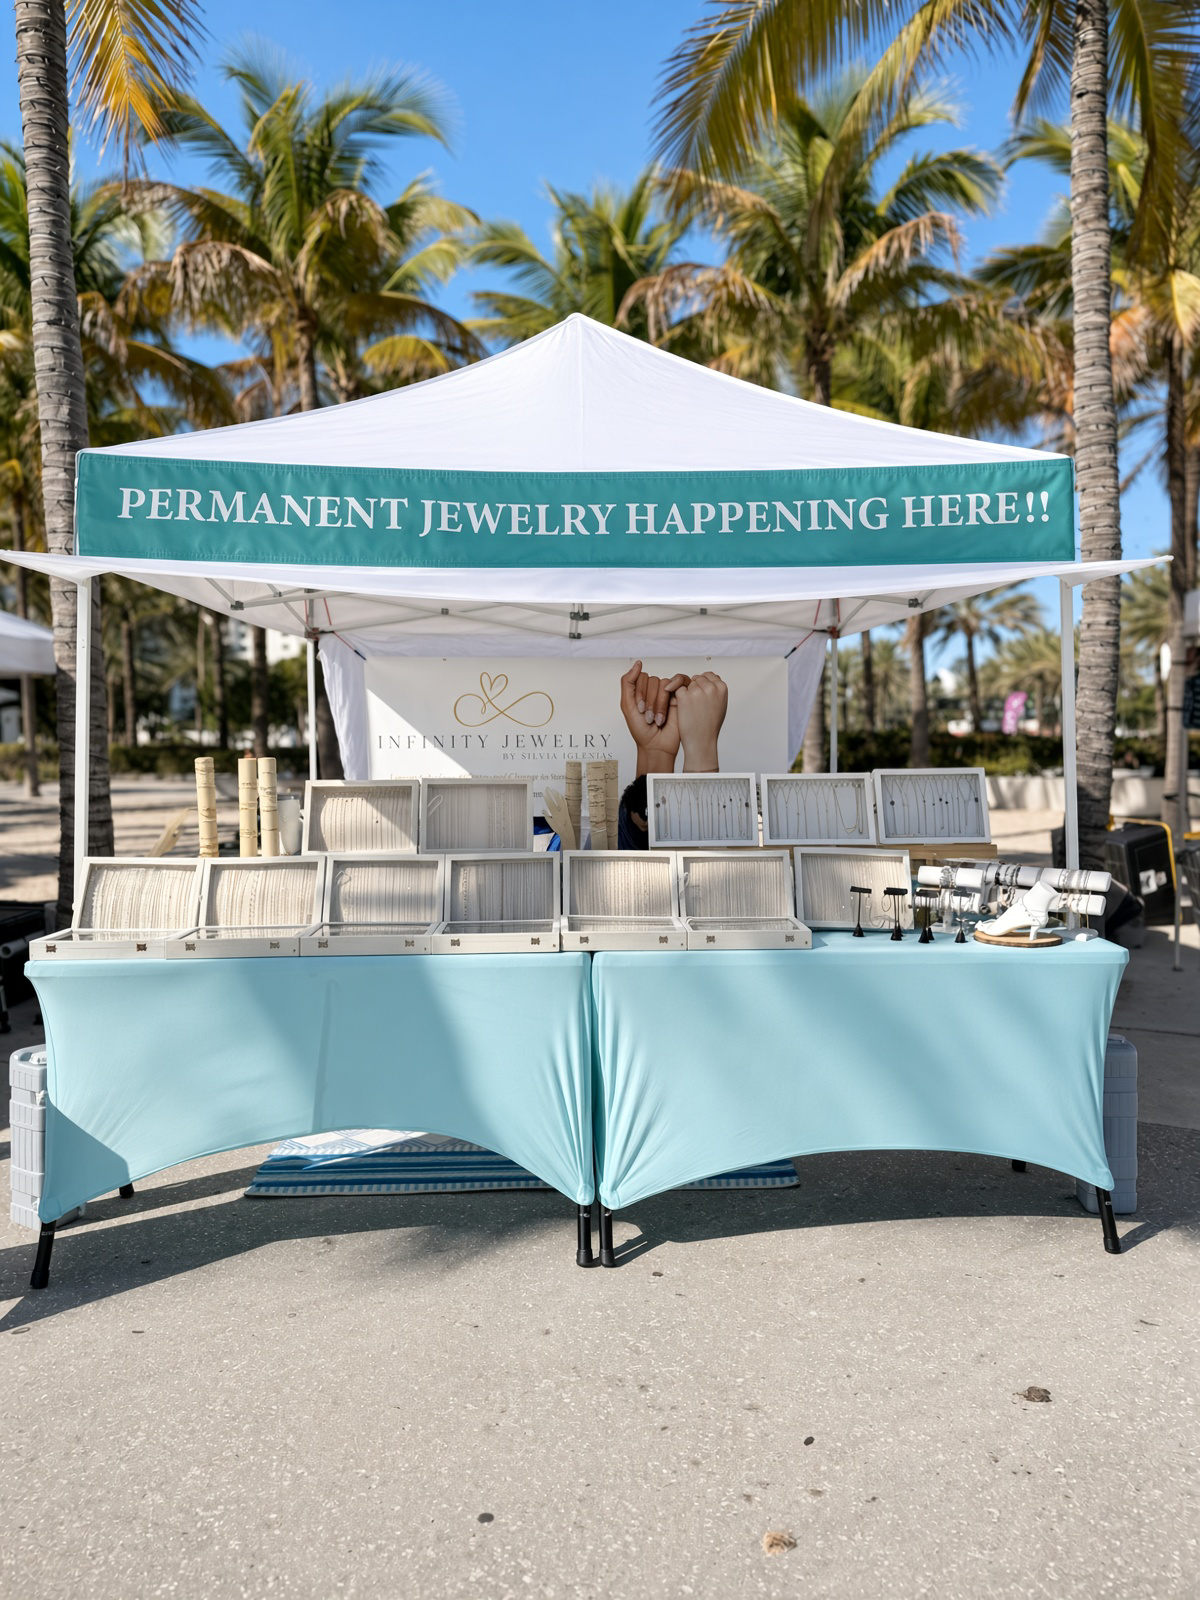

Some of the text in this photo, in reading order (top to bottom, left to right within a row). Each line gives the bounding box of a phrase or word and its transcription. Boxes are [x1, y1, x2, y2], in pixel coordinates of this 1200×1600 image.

[117, 487, 1050, 538] PERMANENT JEWELRY HAPPENING HERE!!
[378, 734, 612, 749] INFINITY JEWELRY
[502, 752, 516, 760] BY
[521, 752, 558, 760] SILVIA
